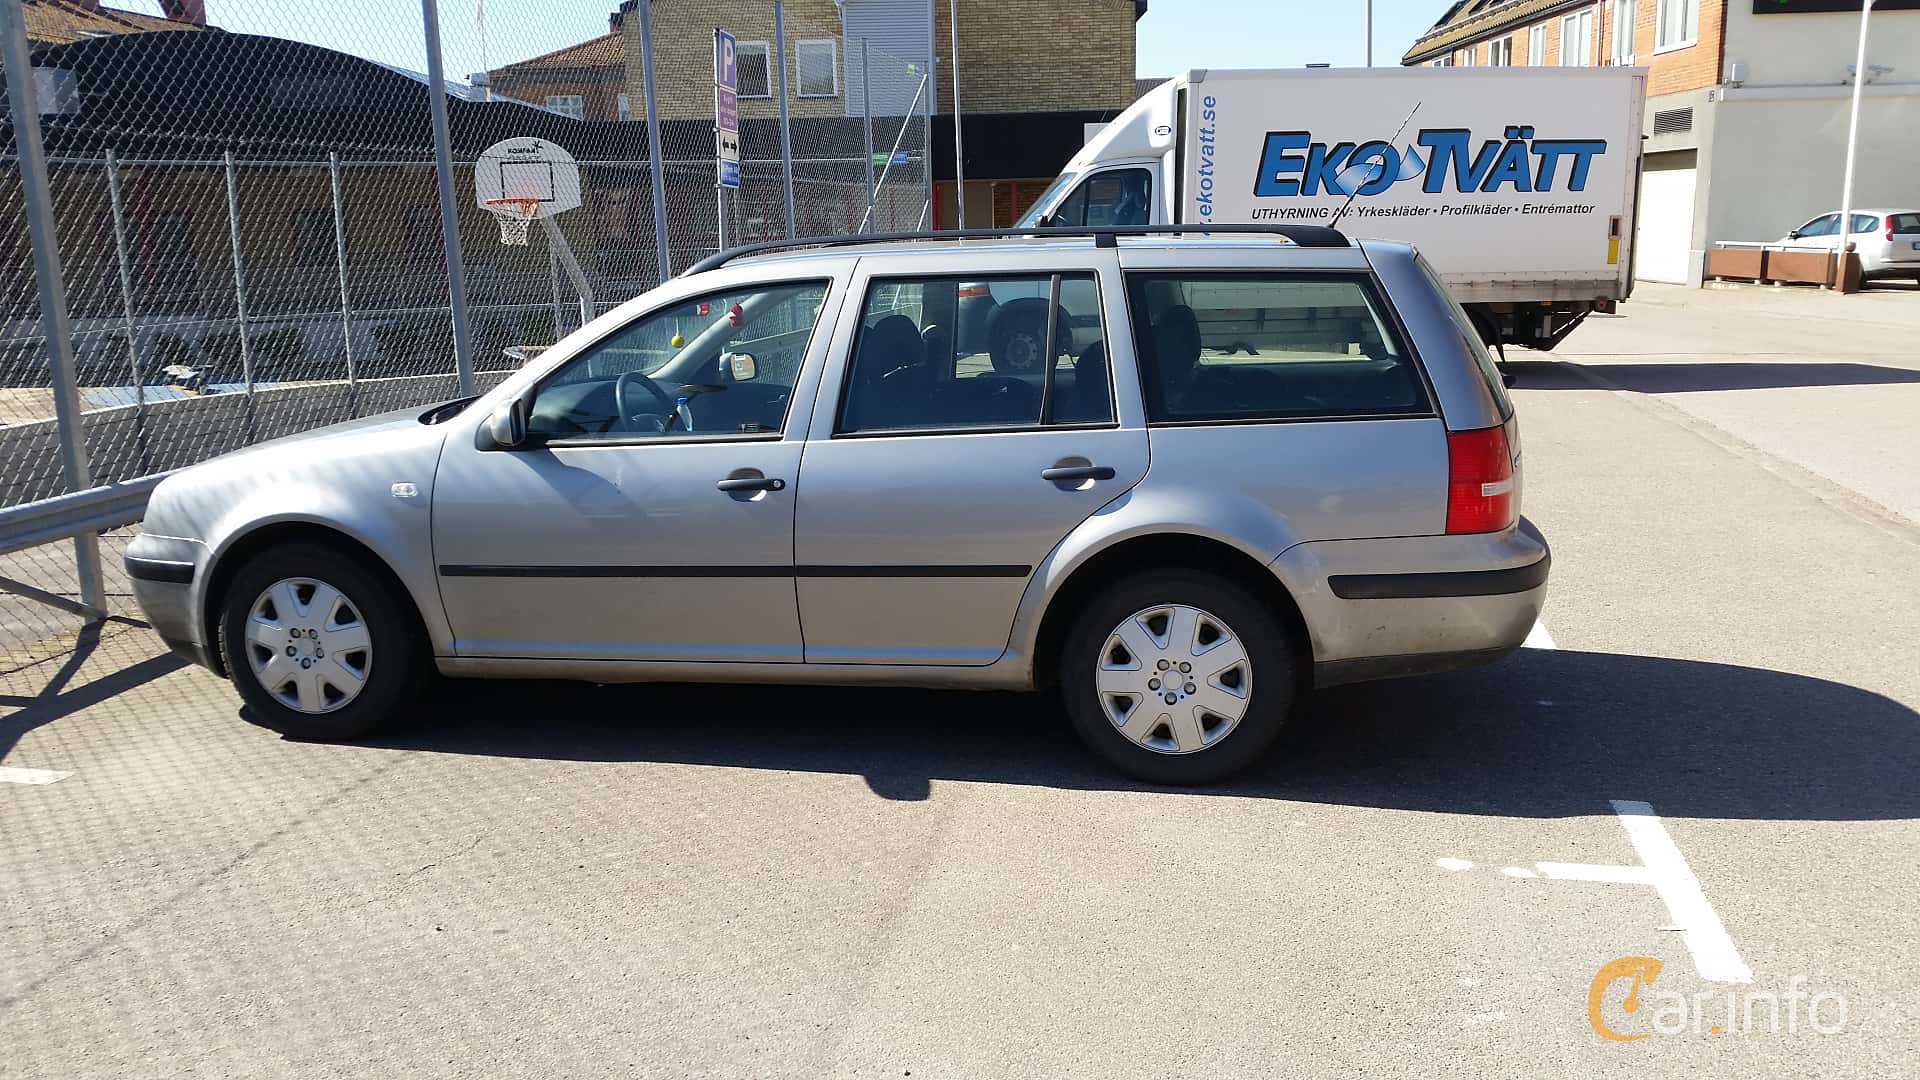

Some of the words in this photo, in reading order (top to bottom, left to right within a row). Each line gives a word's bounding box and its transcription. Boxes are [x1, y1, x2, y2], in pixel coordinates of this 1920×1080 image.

[724, 37, 734, 81] P
[1417, 126, 1607, 193] TVÄTT
[1252, 207, 1329, 219] UTHYRNING
[1357, 205, 1430, 217] Yrkeskläder
[1440, 204, 1512, 216] Profilkläder
[1522, 203, 1595, 215] Entrémattor
